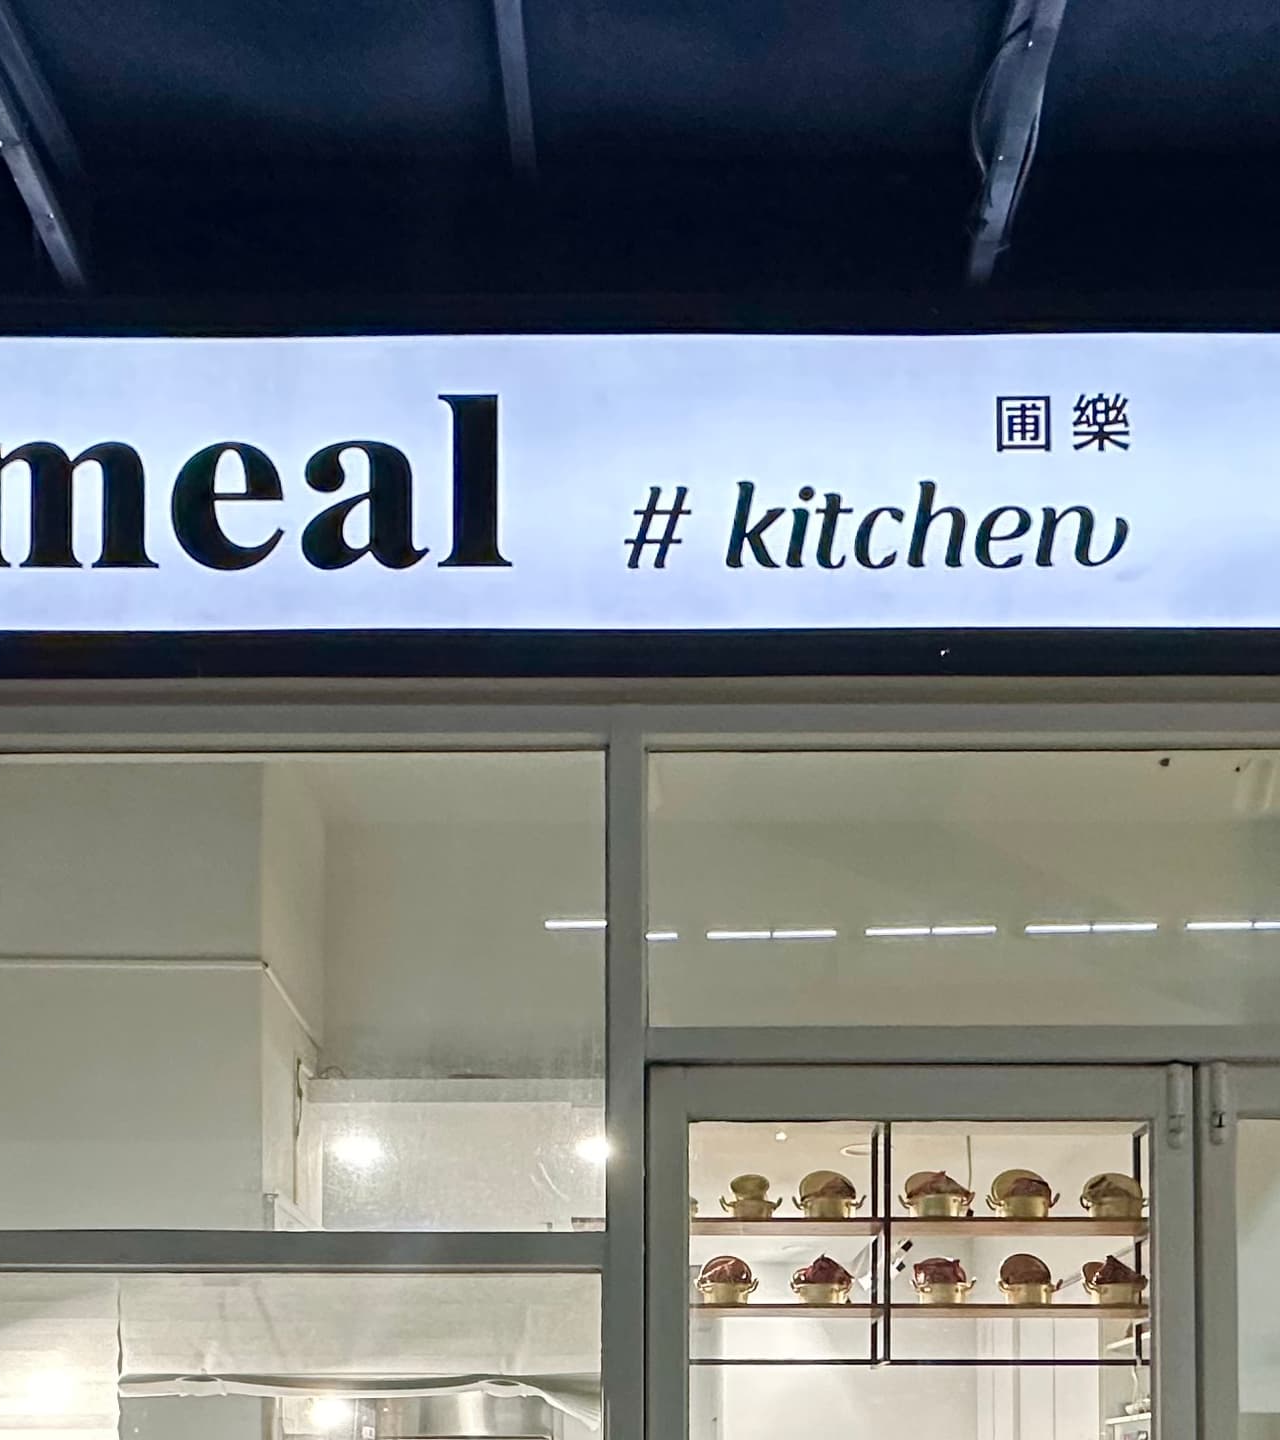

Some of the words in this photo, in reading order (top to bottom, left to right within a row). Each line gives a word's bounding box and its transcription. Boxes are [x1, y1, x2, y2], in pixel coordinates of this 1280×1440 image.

[996, 392, 1131, 452] 圃樂
[625, 485, 691, 569] #
[724, 478, 1130, 569] kitchen
